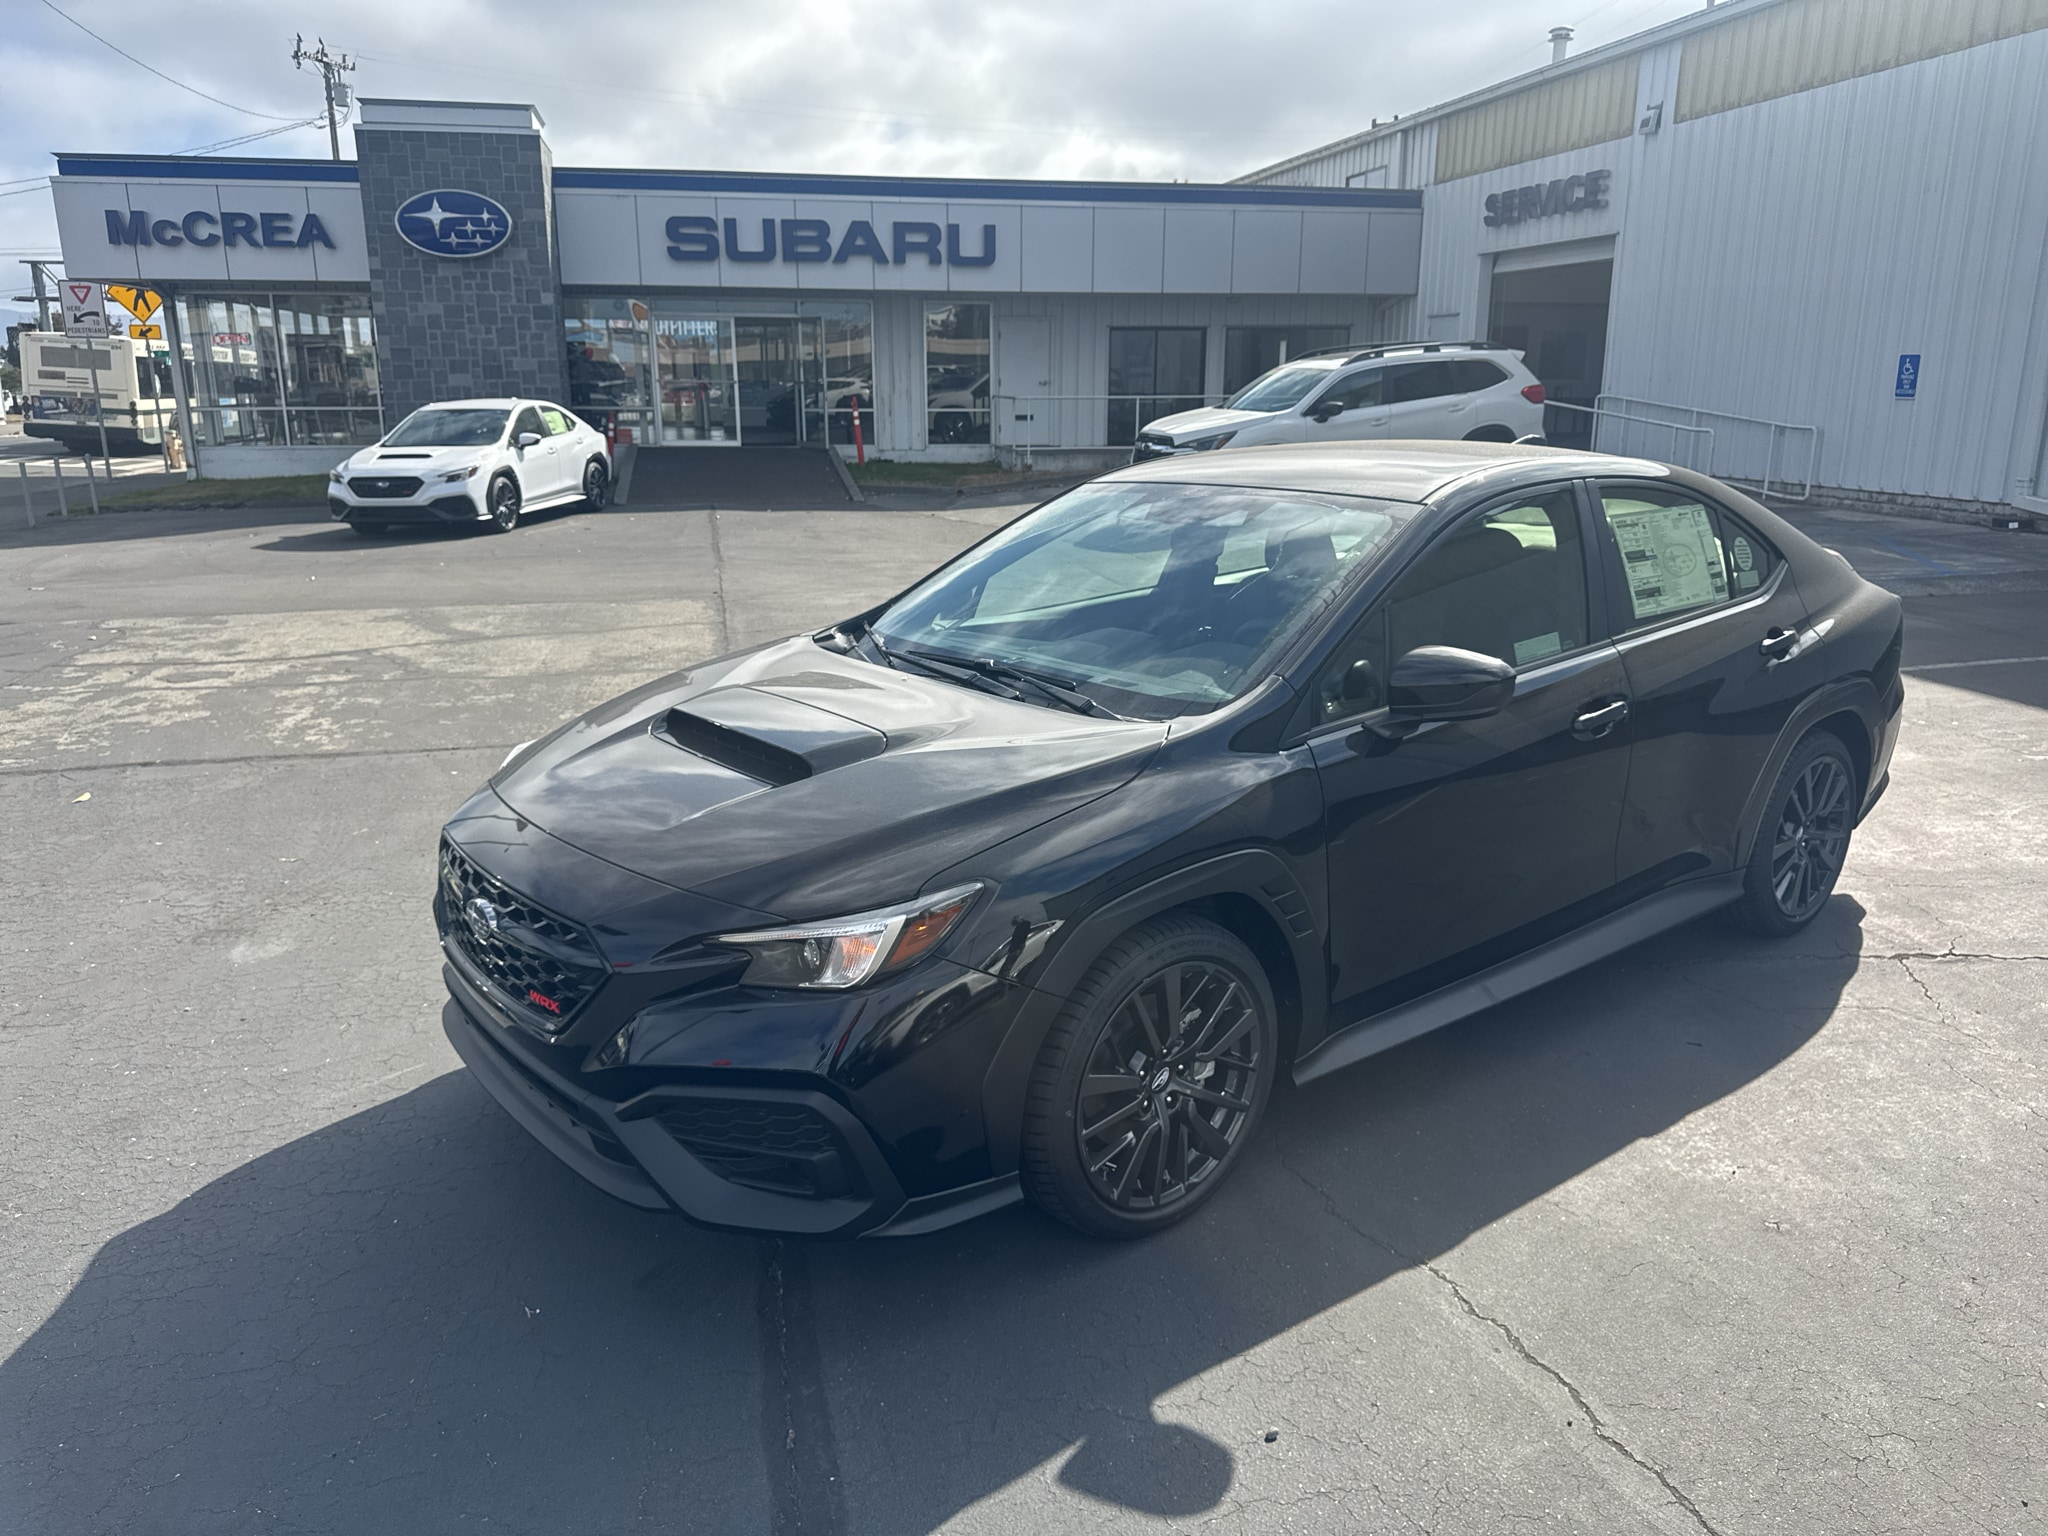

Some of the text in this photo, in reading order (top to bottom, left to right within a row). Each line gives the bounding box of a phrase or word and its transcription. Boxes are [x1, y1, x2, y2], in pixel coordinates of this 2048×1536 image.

[1483, 169, 1611, 227] SERVICE
[104, 209, 337, 250] McCREA
[665, 216, 996, 267] SUBARU
[529, 989, 560, 1014] WRX
